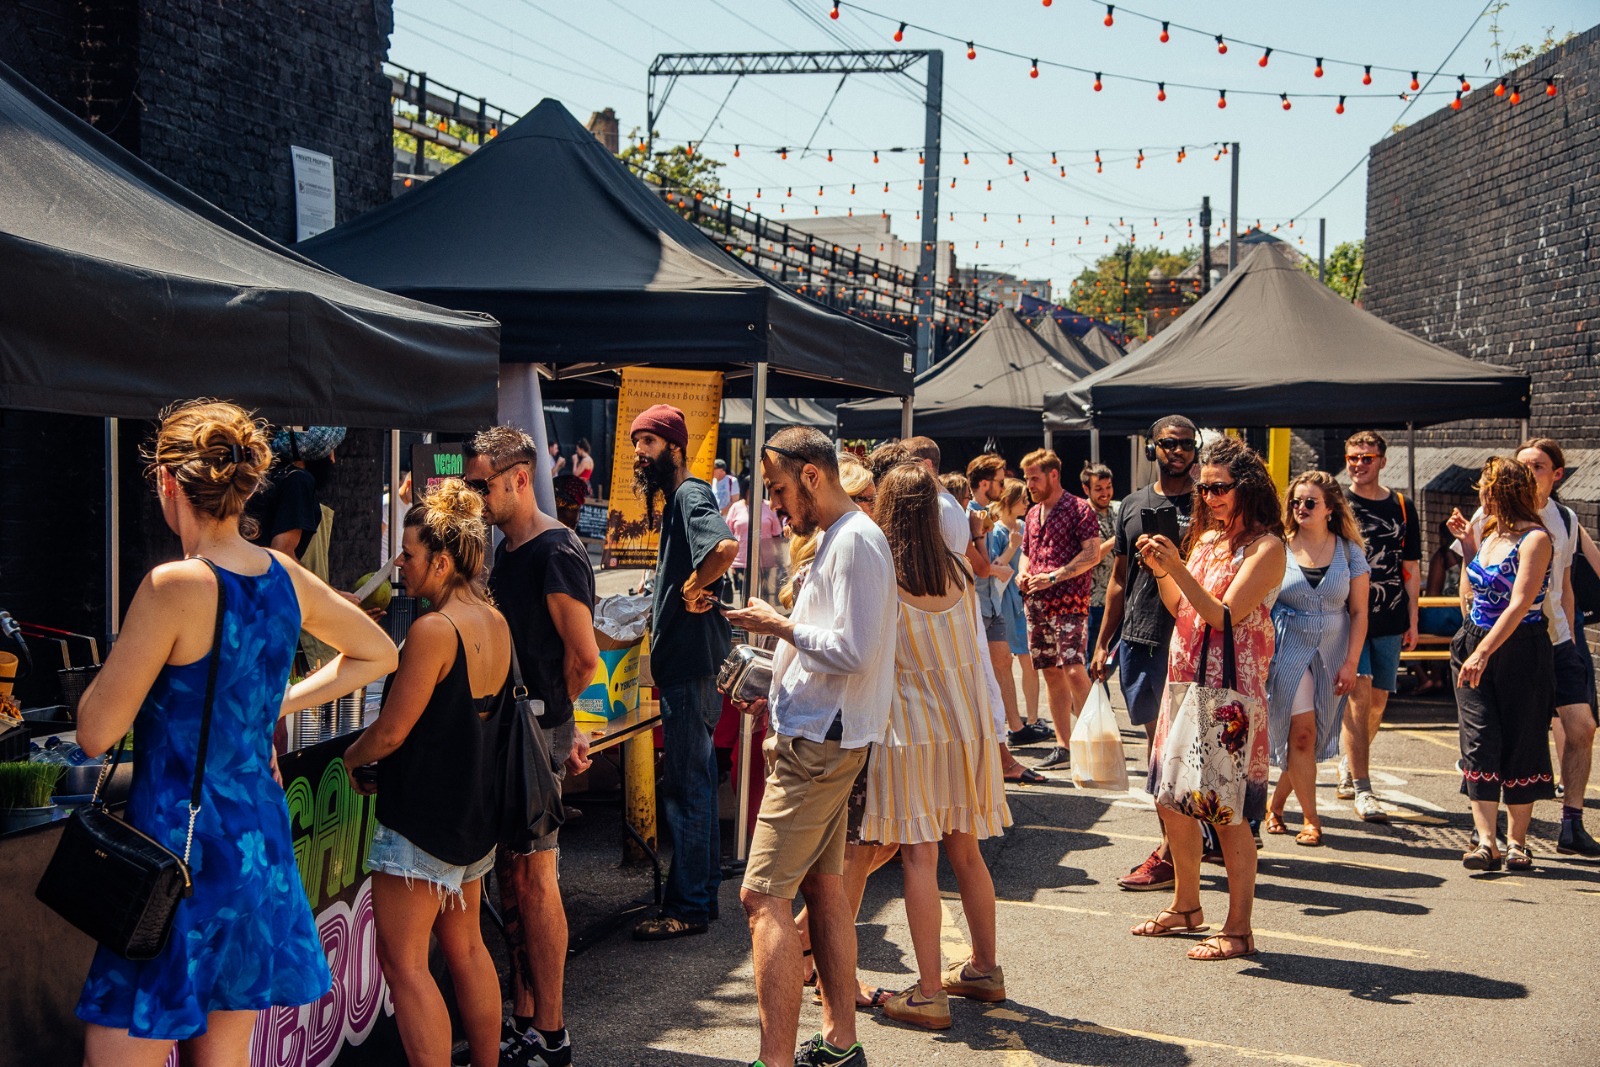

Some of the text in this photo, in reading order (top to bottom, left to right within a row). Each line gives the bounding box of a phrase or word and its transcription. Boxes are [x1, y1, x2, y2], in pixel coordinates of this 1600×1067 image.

[295, 153, 312, 162] PRIVATE
[627, 388, 710, 402] RAINFOREST BOXES
[433, 453, 463, 475] VEGAN
